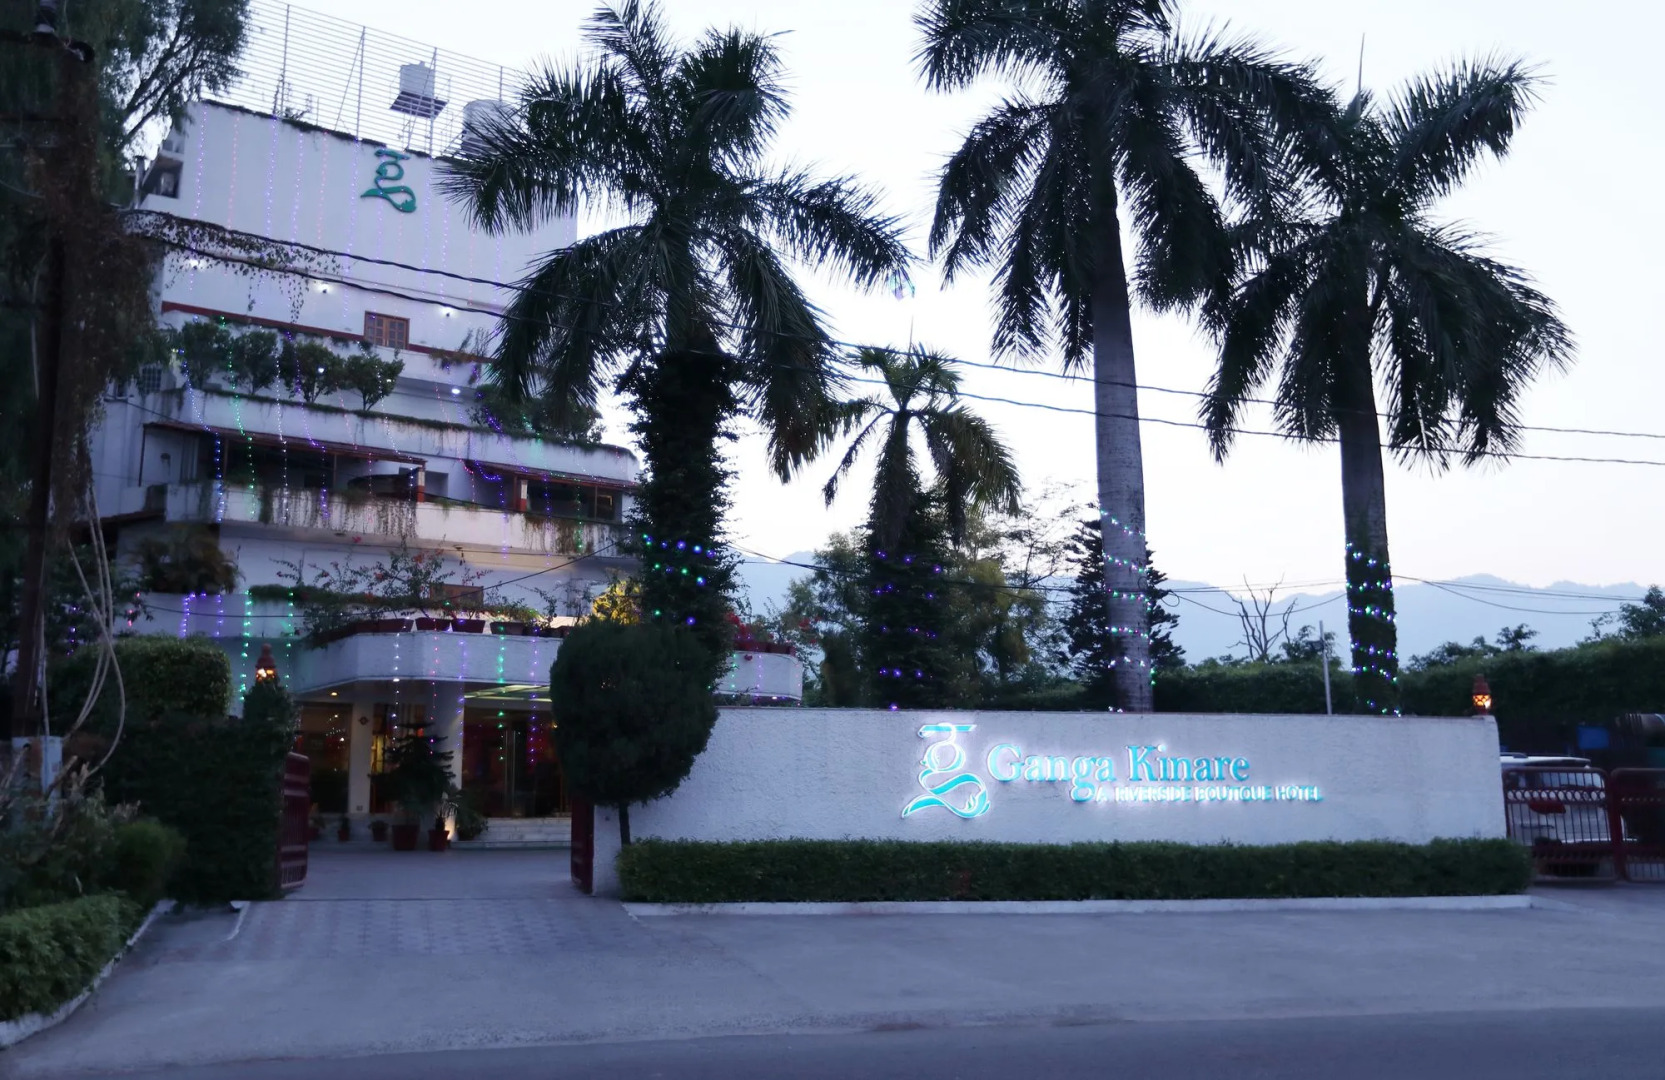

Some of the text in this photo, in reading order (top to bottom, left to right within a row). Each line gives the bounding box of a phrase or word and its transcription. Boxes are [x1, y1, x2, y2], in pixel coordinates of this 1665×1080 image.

[987, 743, 1250, 803] Ganga Kinare
[1115, 786, 1192, 803] RIVERSIDE
[1194, 786, 1273, 803] BOUTIQUE
[1275, 785, 1324, 802] HOTEL
